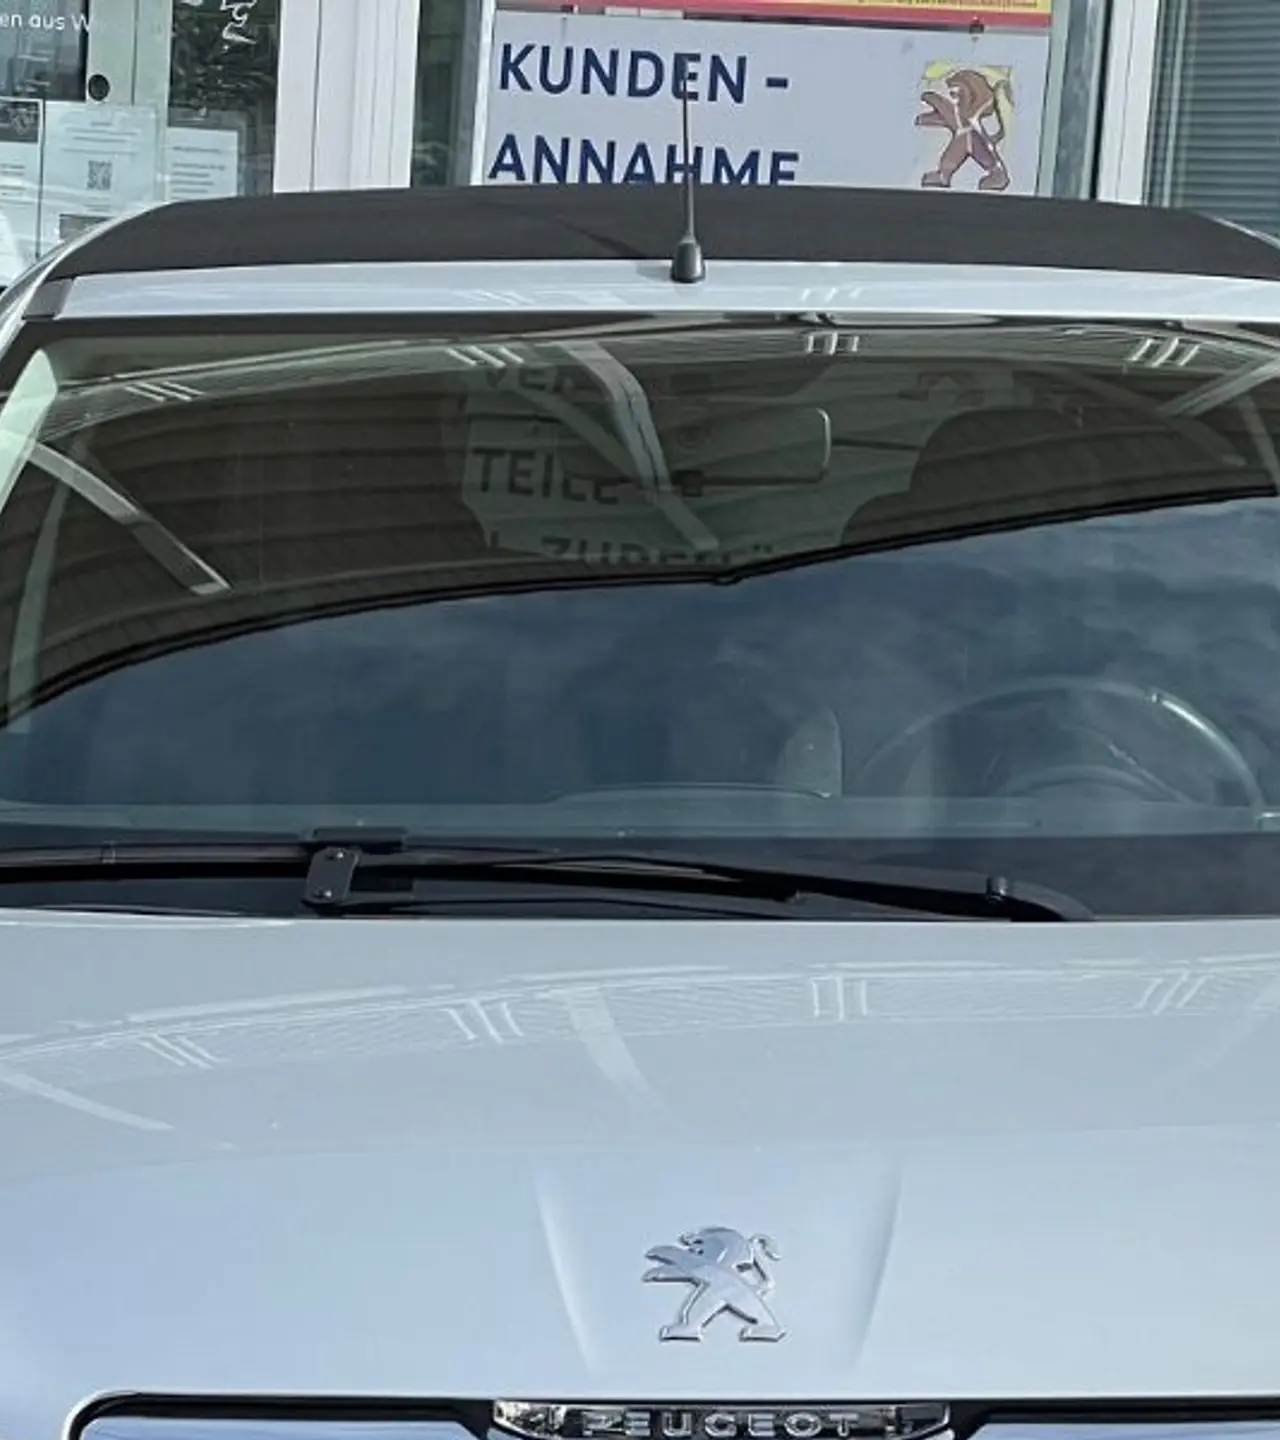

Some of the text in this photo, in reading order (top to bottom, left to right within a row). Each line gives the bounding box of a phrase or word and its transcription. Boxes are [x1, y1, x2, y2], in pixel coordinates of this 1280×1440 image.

[28, 13, 65, 31] aus
[499, 43, 747, 104] KUNDEN
[488, 133, 799, 185] ANNAHME
[581, 1410, 859, 1438] PEUGEOT
